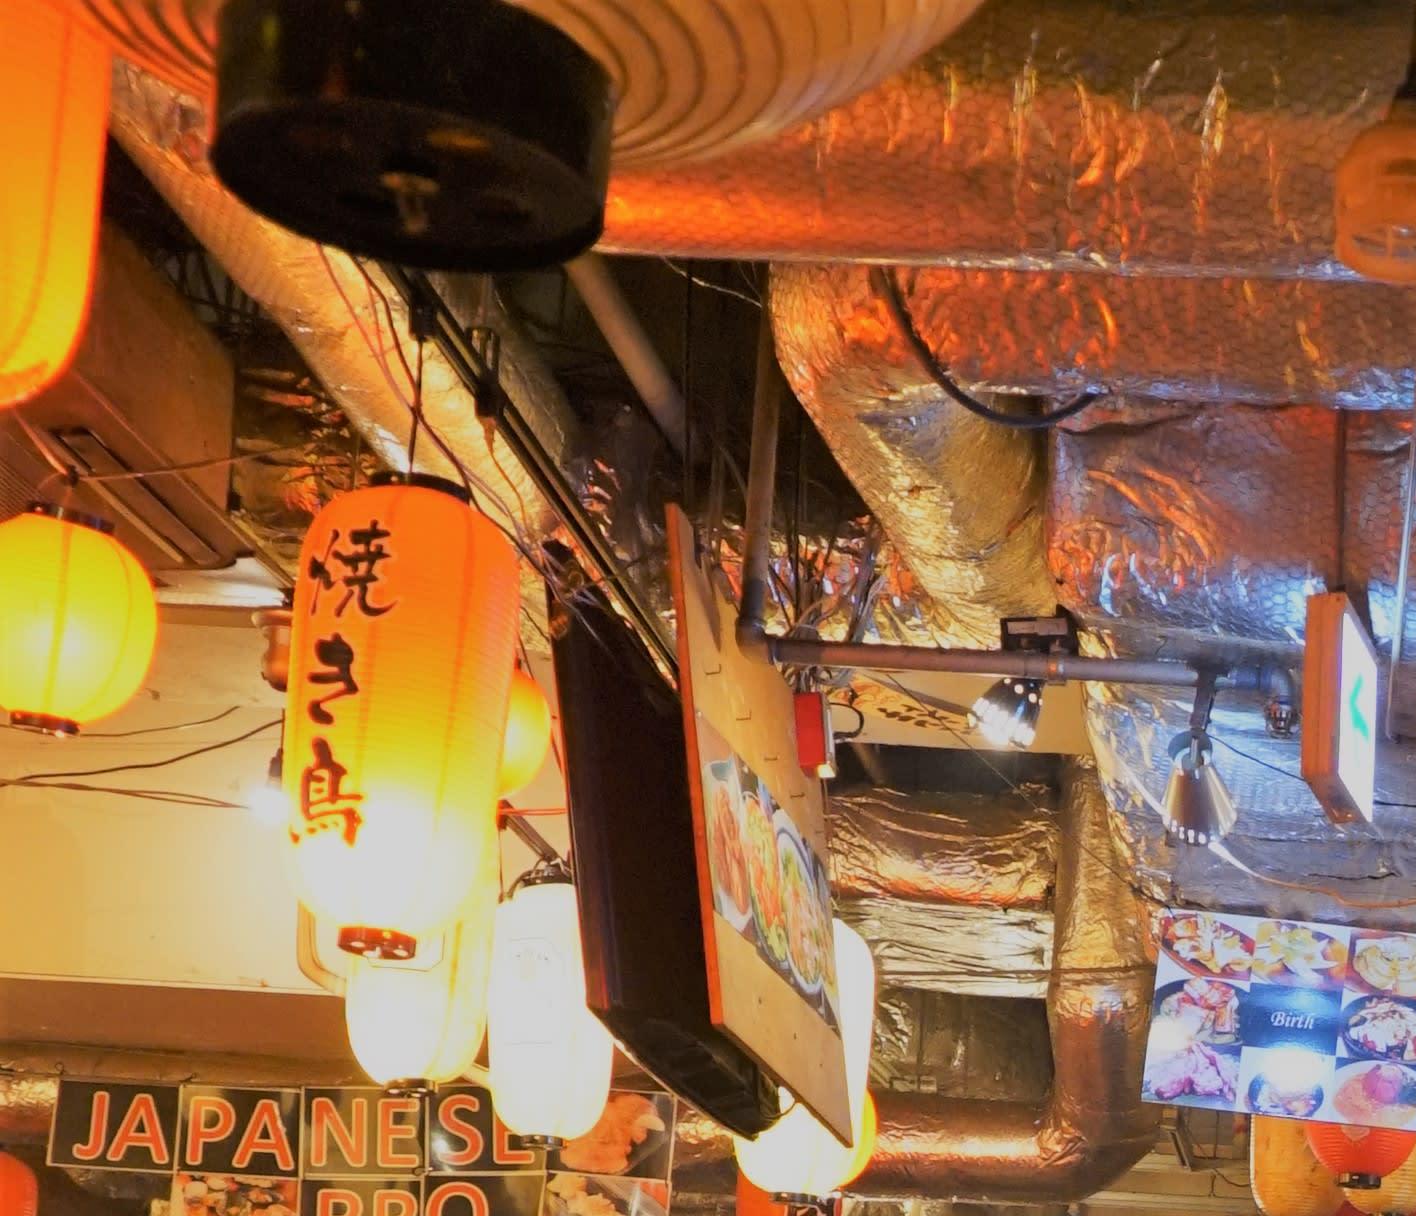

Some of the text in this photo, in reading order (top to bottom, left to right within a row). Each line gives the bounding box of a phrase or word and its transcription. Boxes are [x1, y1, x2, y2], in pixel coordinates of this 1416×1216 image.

[289, 520, 399, 847] 焼き鳥
[1271, 1011, 1315, 1030] Birth
